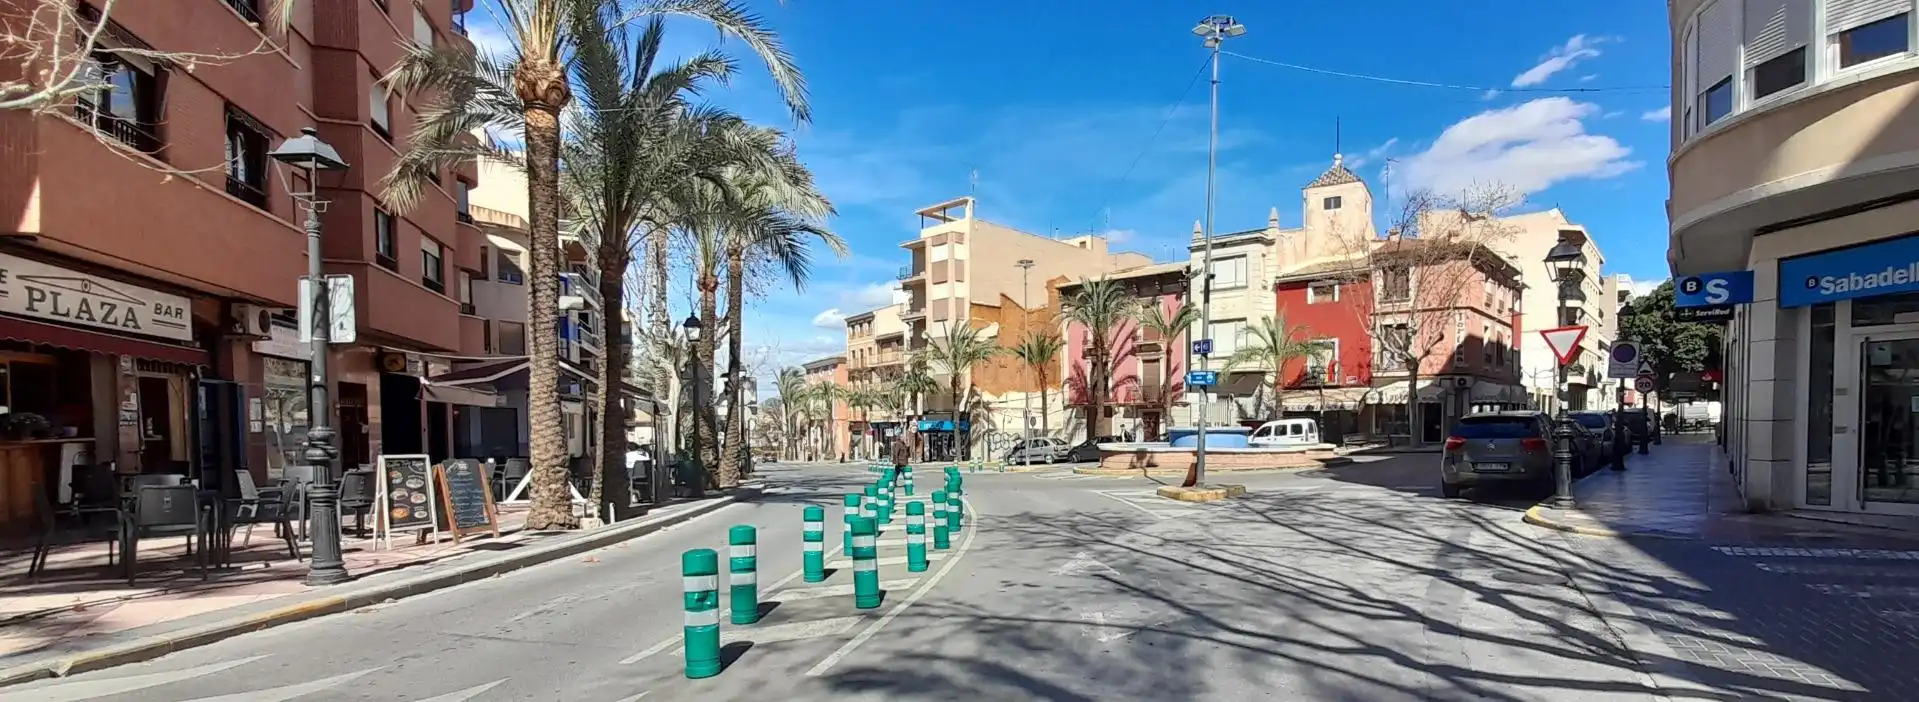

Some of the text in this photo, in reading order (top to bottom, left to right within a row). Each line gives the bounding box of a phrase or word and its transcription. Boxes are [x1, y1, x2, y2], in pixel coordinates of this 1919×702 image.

[1686, 278, 1730, 304] B S
[1820, 261, 1919, 295] Sabadell
[24, 285, 142, 330] PLAZA
[154, 302, 184, 320] BAR
